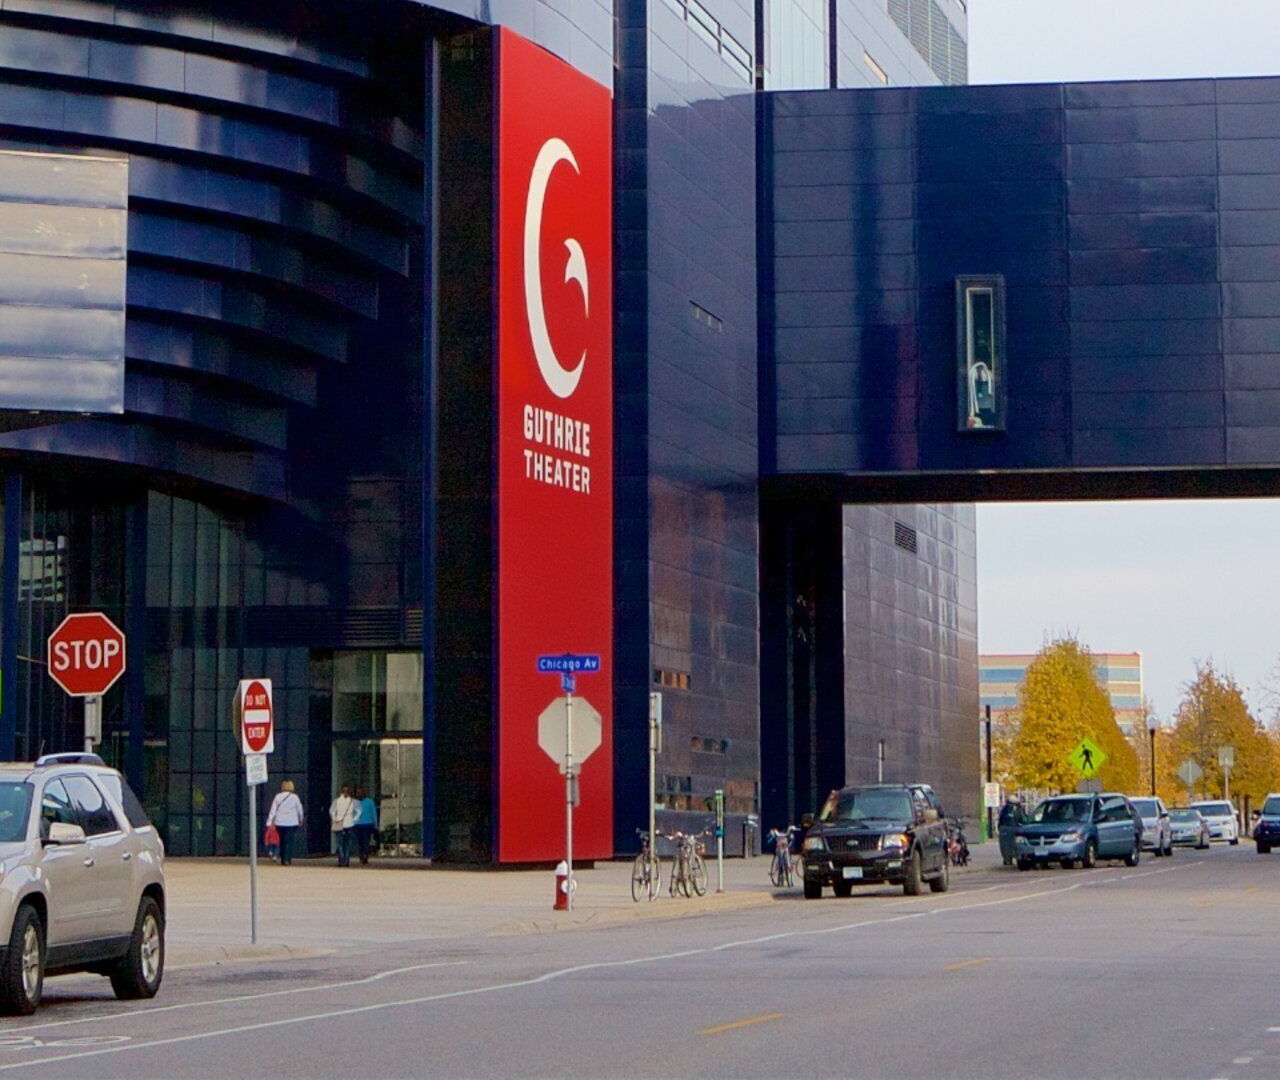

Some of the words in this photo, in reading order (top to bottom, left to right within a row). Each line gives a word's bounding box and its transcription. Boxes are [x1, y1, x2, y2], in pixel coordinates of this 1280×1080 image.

[523, 404, 590, 458] GUTHRIE
[523, 449, 590, 495] THEATER
[53, 639, 120, 671] STOP
[540, 658, 581, 671] Chicago
[583, 658, 597, 669] Av
[246, 694, 254, 707] DO
[255, 694, 266, 706] NOT
[247, 727, 266, 740] ENTER
